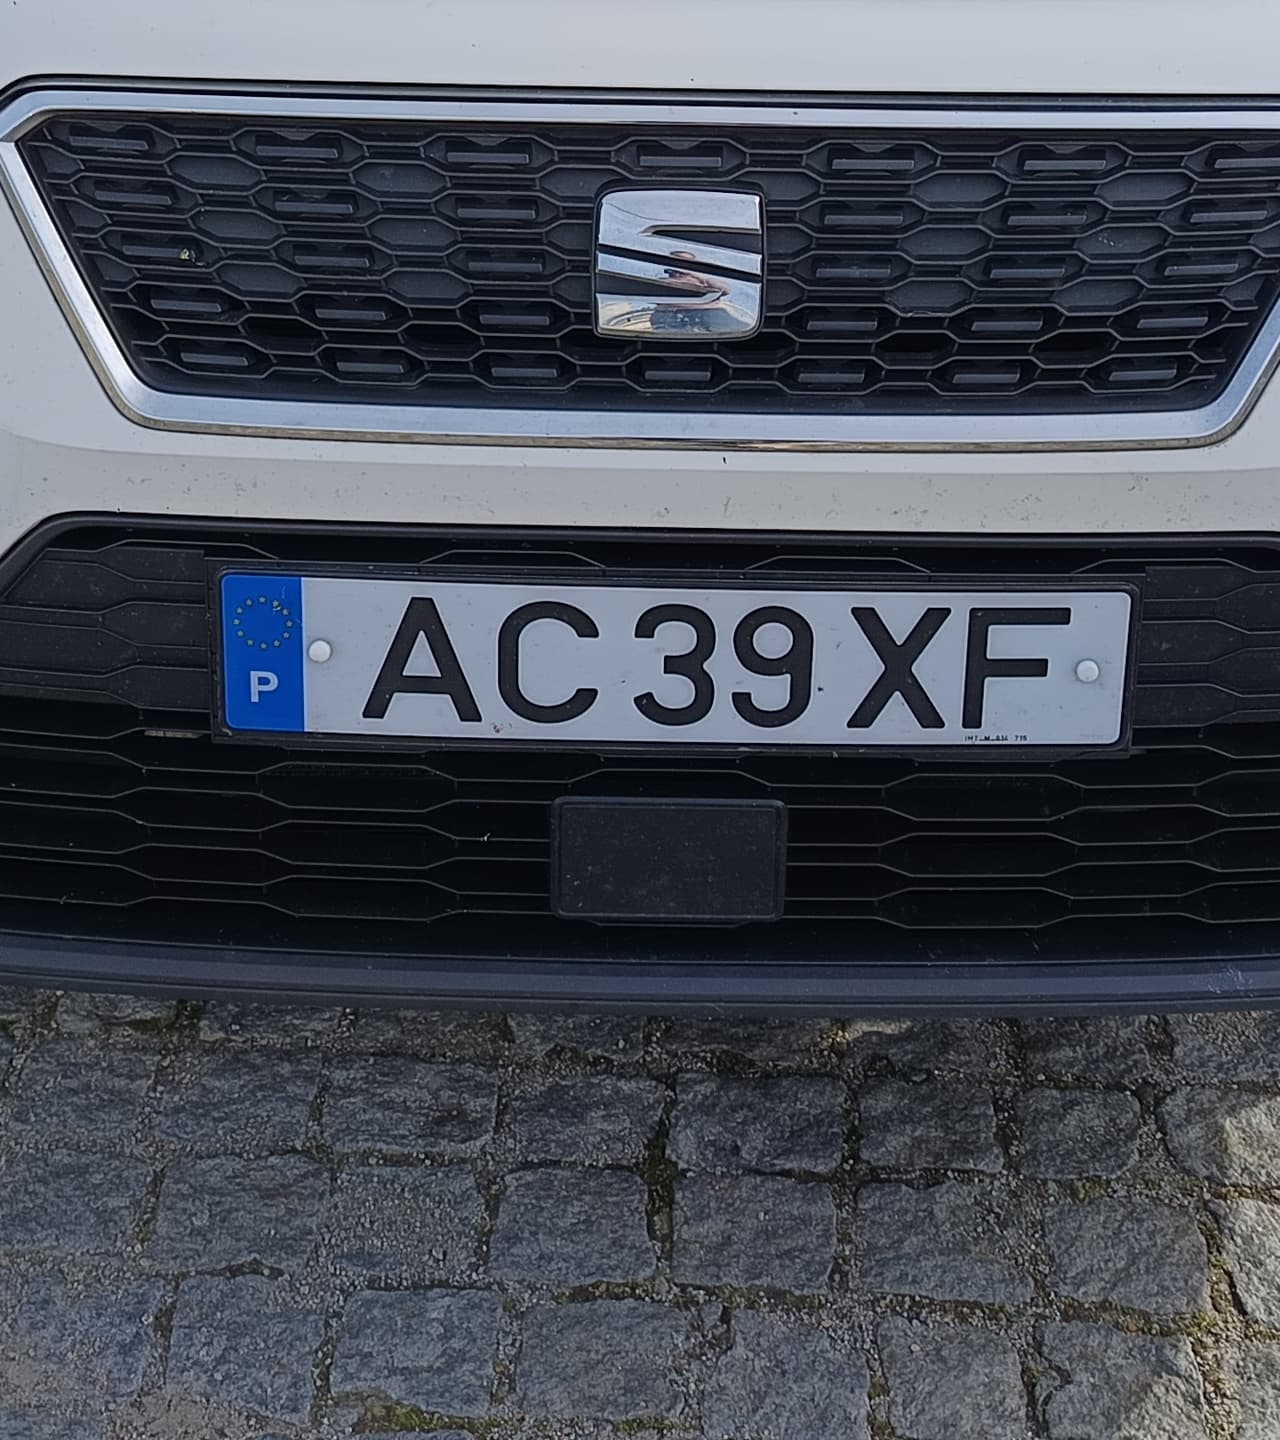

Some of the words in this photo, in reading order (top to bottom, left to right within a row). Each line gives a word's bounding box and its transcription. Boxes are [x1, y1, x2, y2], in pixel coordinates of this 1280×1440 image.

[249, 670, 279, 703] P
[362, 596, 600, 724] AC
[633, 603, 815, 728] 39
[846, 606, 1072, 729] XF
